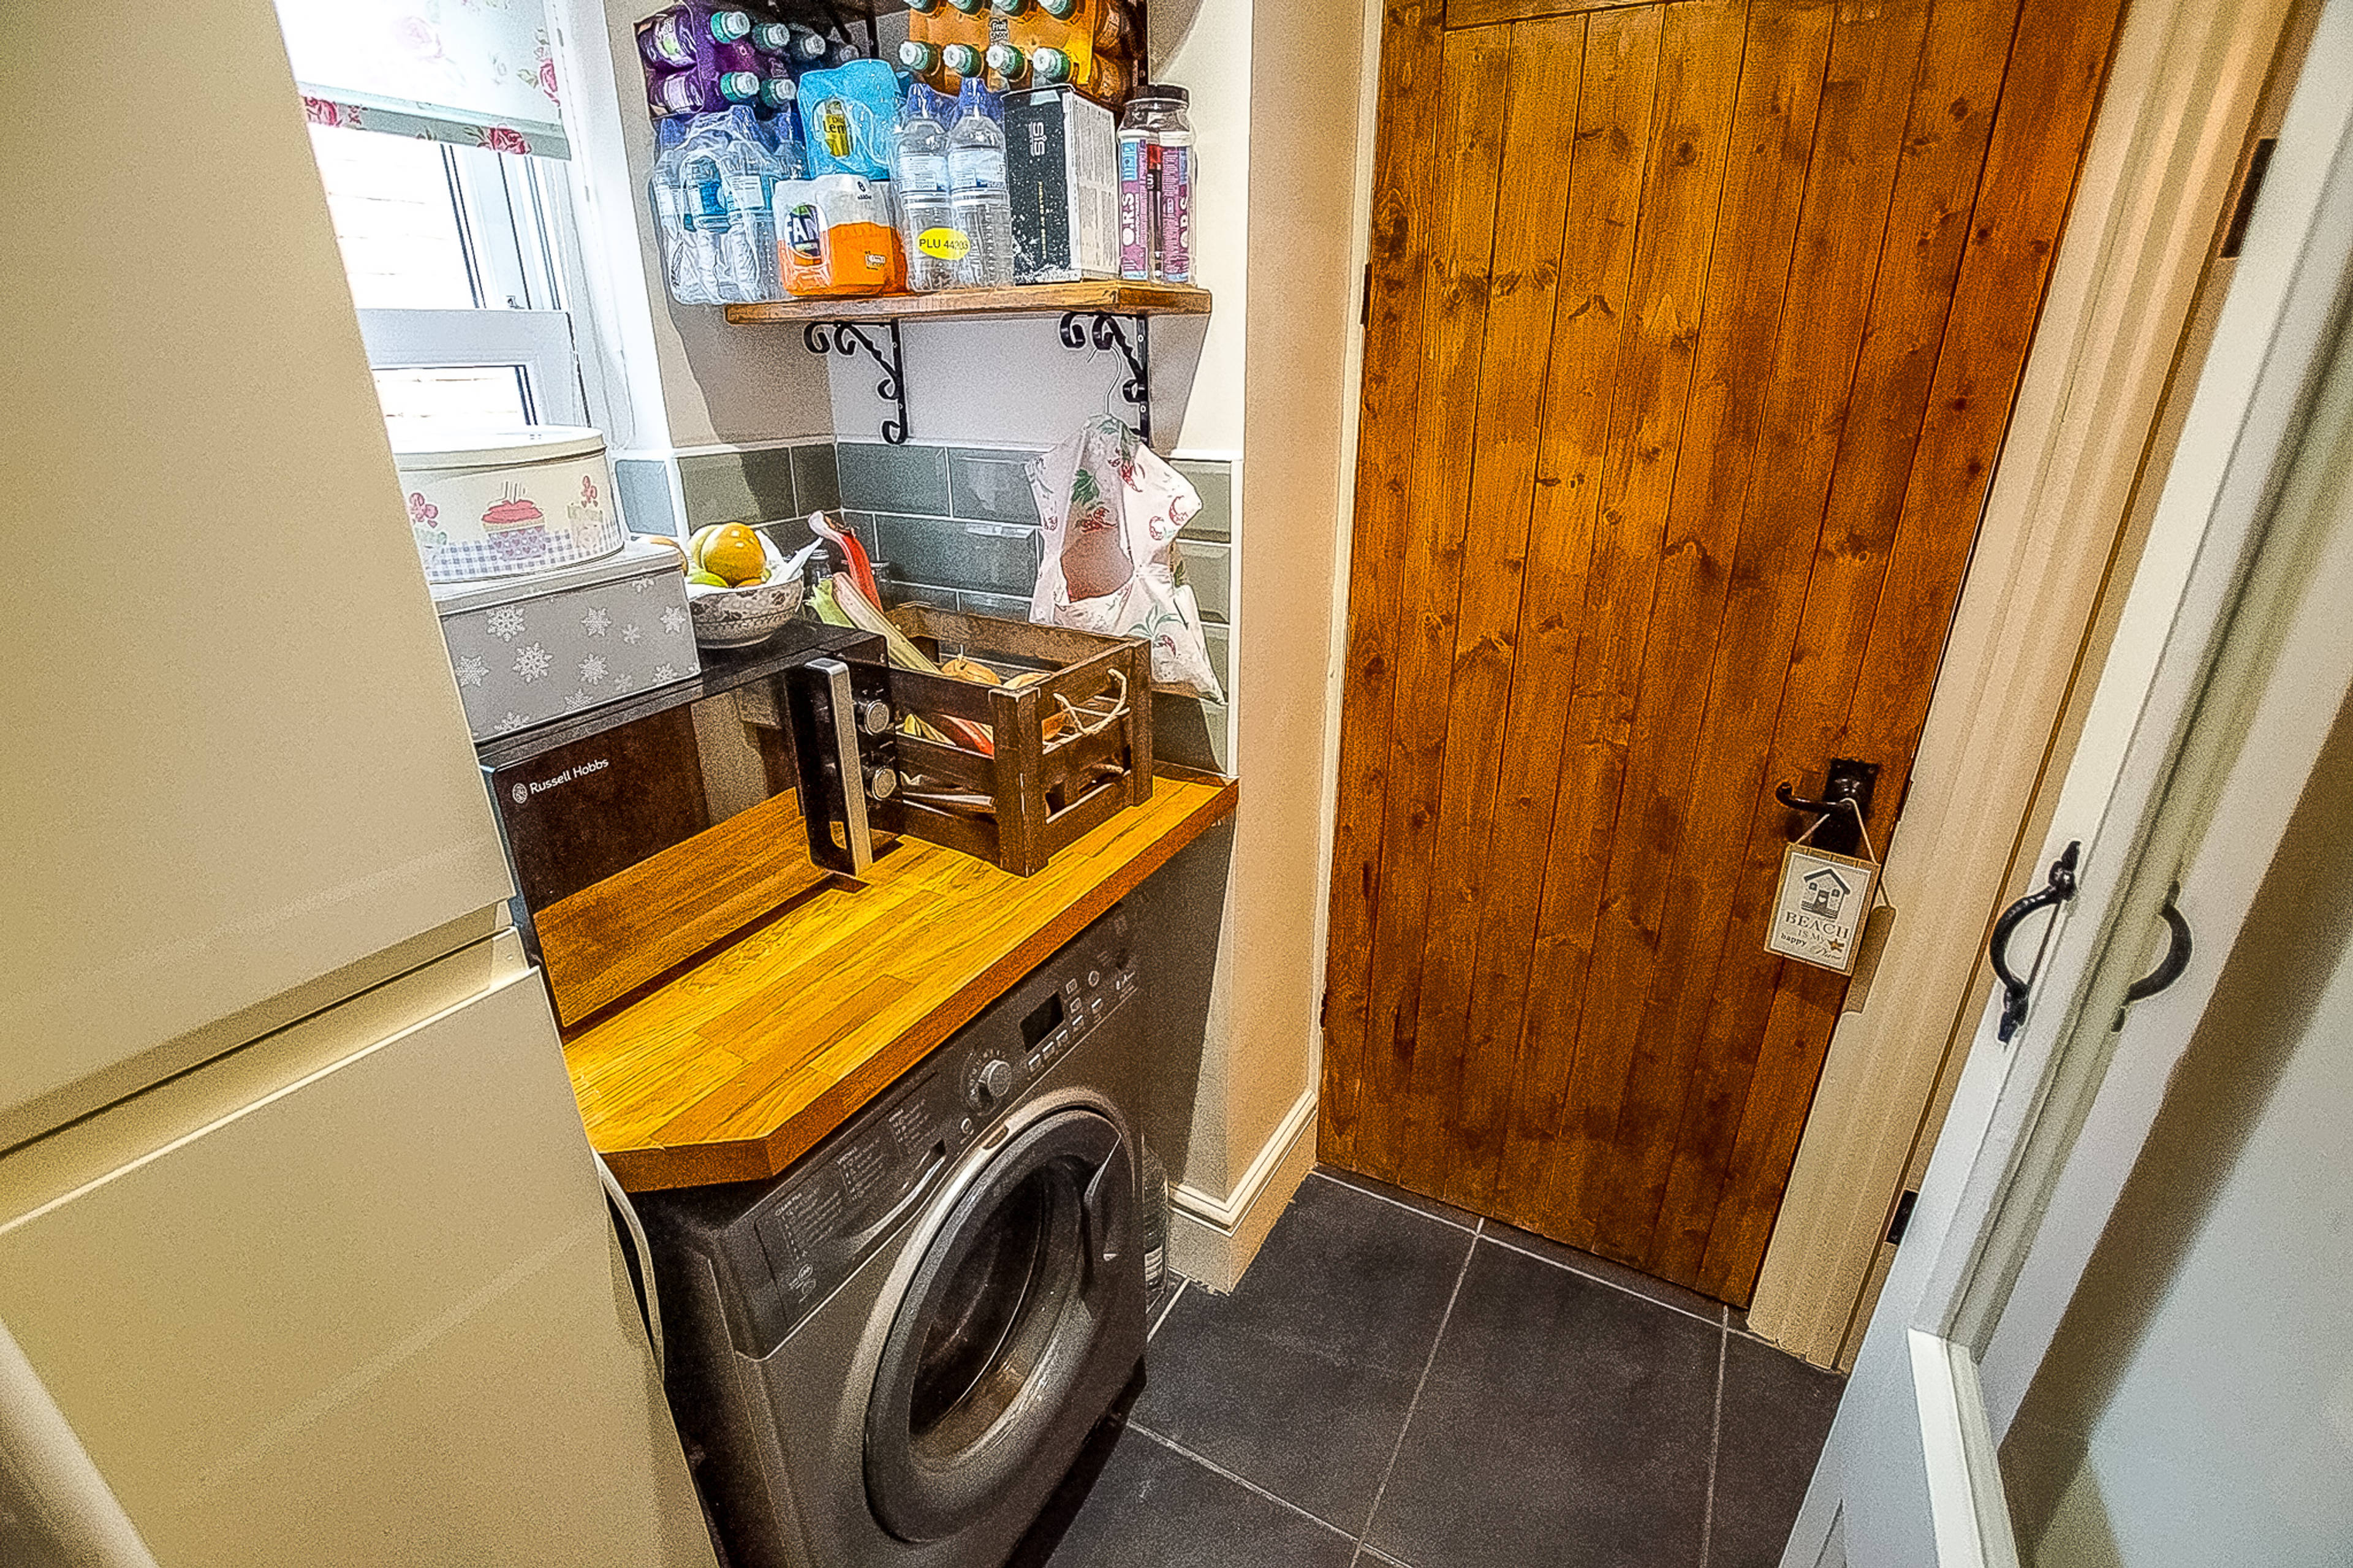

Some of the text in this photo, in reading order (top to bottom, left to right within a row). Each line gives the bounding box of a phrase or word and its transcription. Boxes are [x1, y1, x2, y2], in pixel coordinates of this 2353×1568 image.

[989, 18, 1007, 31] Fruit
[919, 238, 941, 249] PLU
[529, 759, 609, 794] Russell Hobbs
[1785, 911, 1849, 939] BEACH
[1780, 932, 1807, 947] happy
